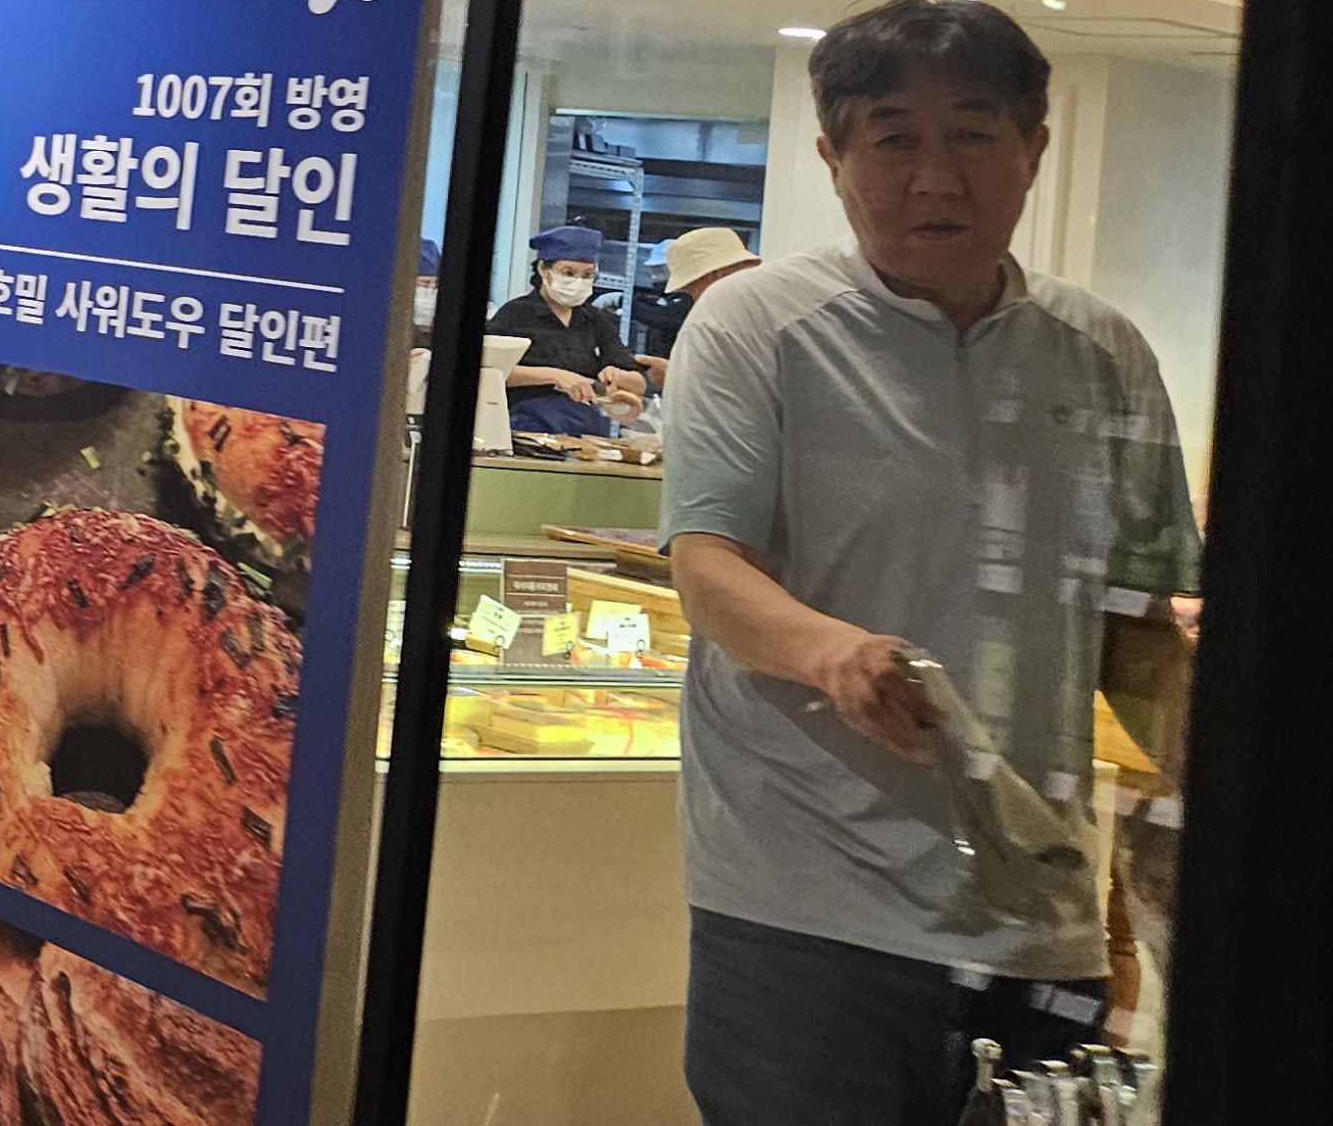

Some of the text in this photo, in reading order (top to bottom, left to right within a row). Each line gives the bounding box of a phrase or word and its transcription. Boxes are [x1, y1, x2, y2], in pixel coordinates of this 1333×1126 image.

[133, 72, 370, 132] 1007회 방영
[20, 133, 358, 246] 생활의 달인
[54, 279, 206, 351] 사워도우
[219, 303, 342, 373] 달인편
